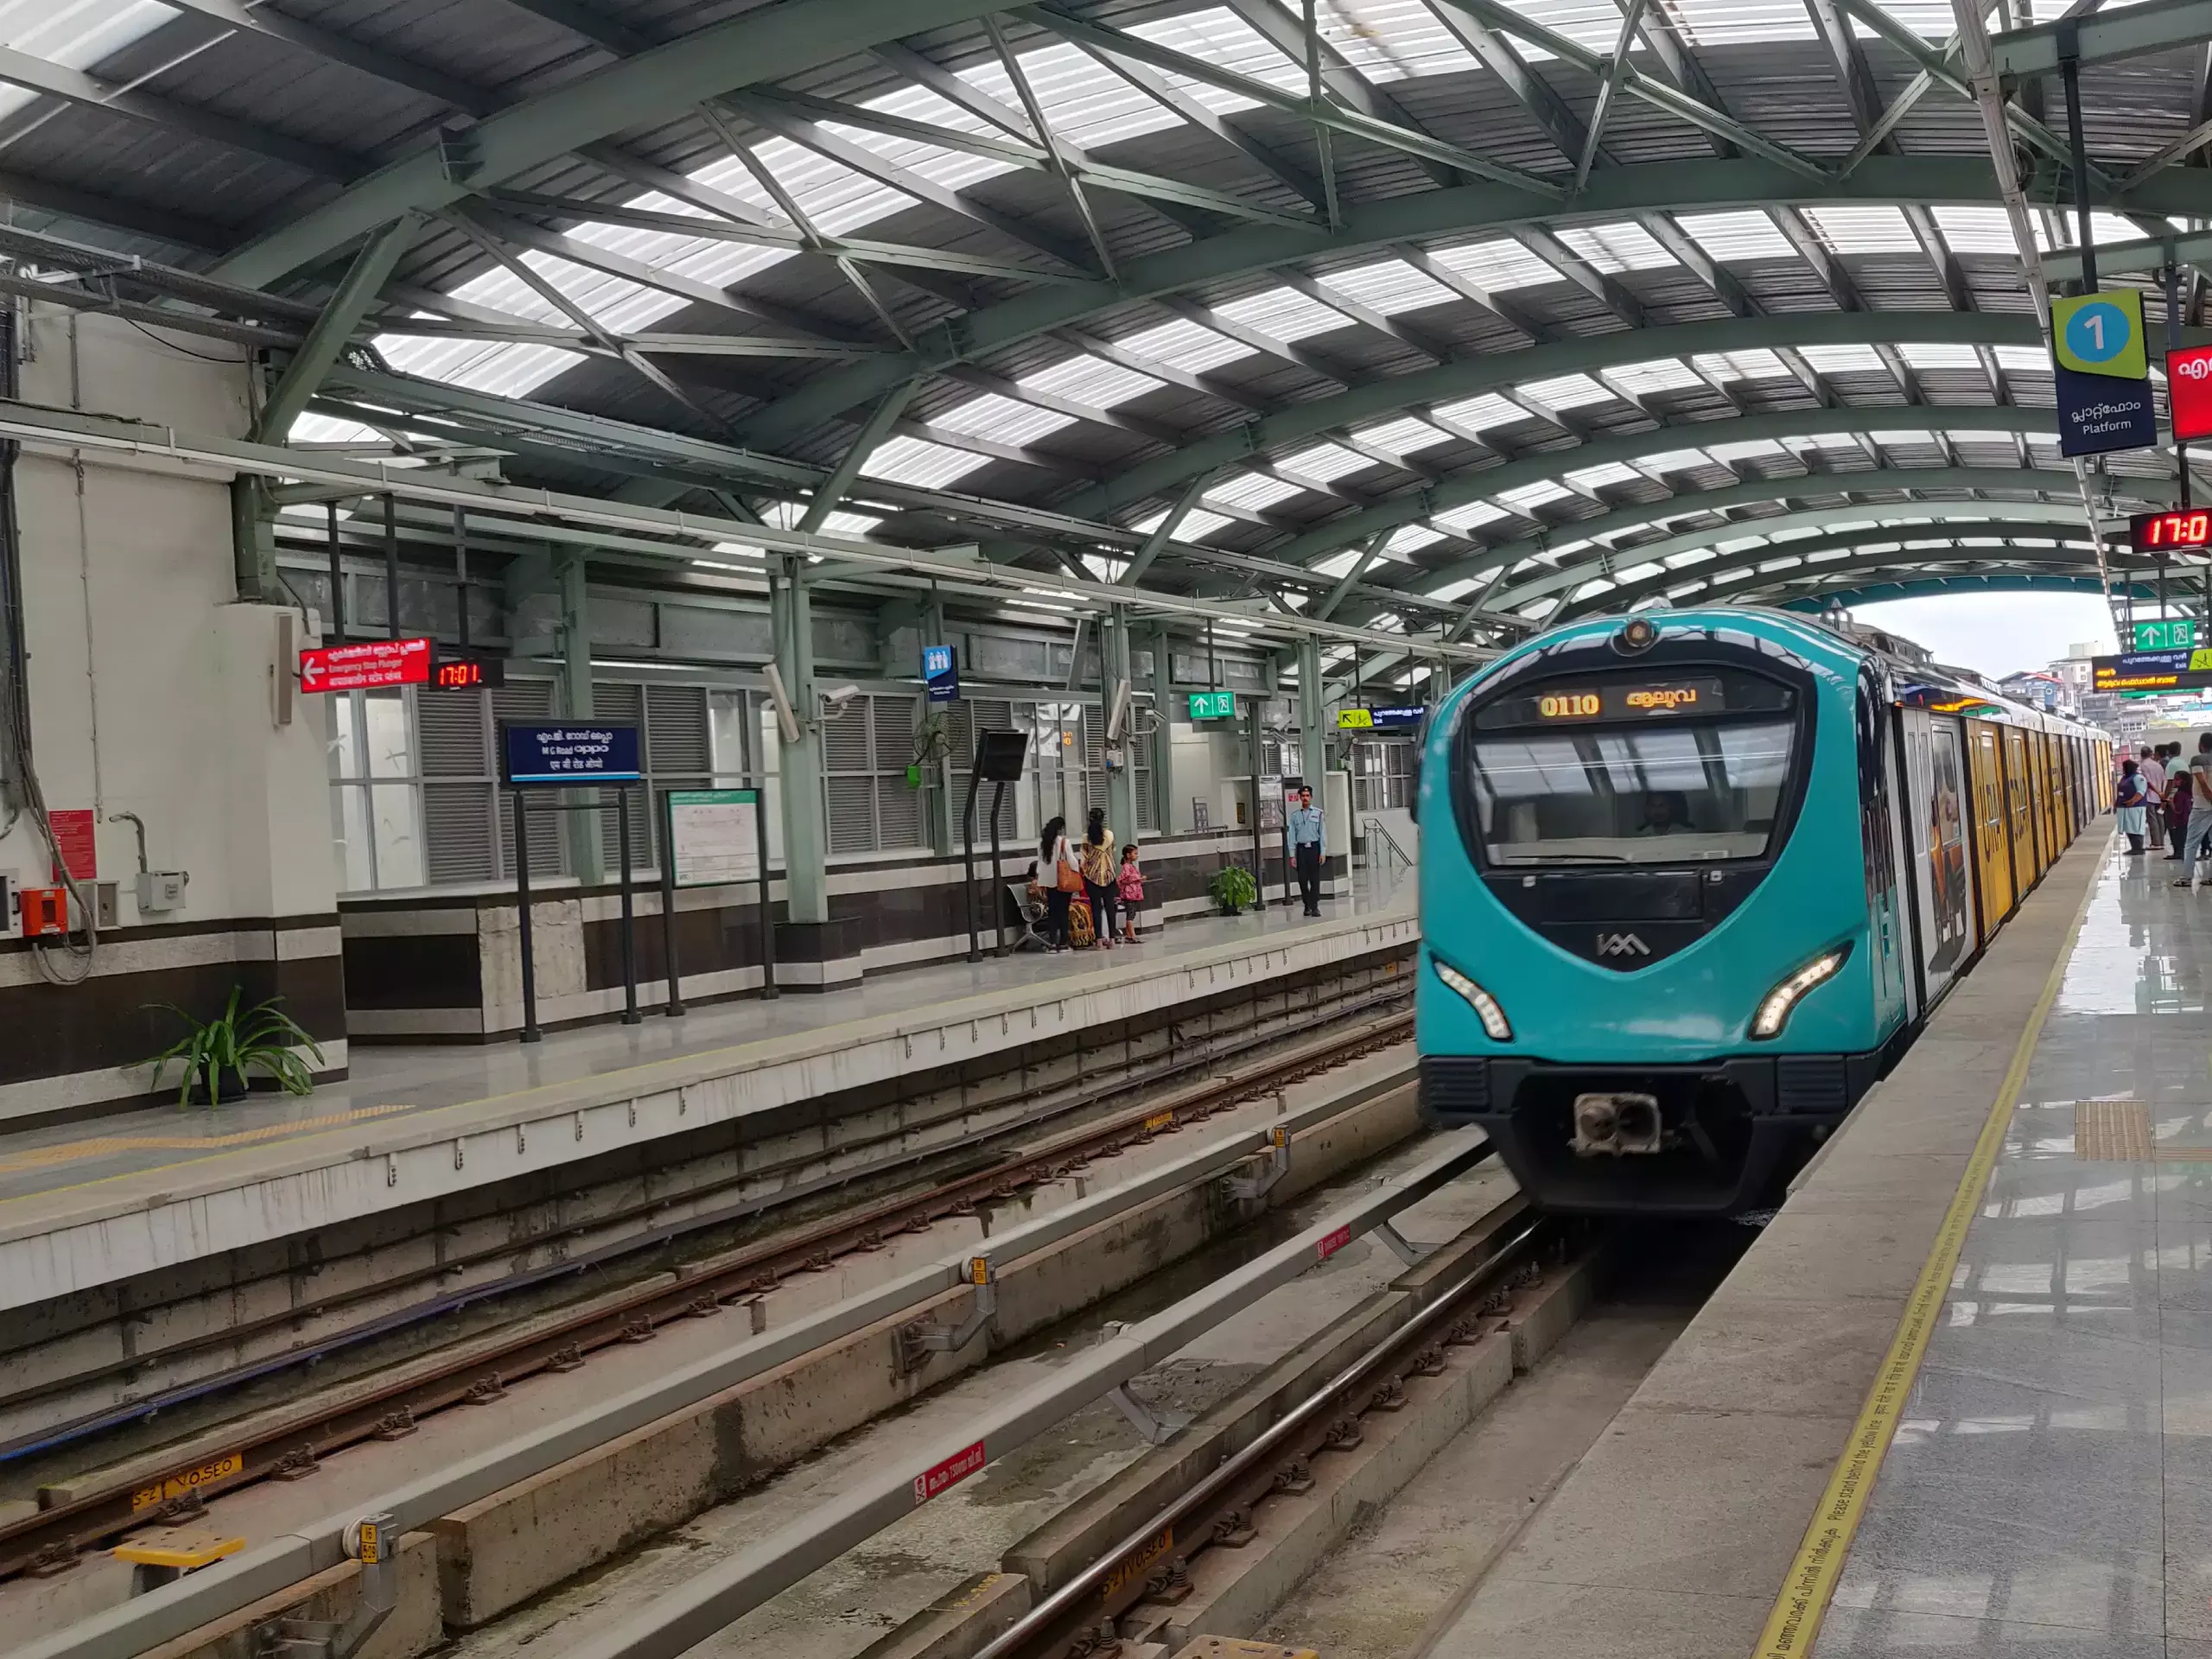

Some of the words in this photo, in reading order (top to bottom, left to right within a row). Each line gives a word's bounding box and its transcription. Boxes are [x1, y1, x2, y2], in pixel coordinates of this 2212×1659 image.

[2083, 315, 2105, 350] 1
[2082, 421, 2132, 435] Platform
[439, 664, 478, 685] 17:01
[1541, 695, 1599, 716] 0110
[1627, 690, 1696, 708] ആലുവ
[1864, 1420, 1882, 1431] line
[1859, 1432, 1878, 1448] yellow
[1853, 1449, 1870, 1459] the
[1843, 1459, 1866, 1480] behind
[1839, 1480, 1858, 1498] stand
[1827, 1498, 1850, 1521] Please
